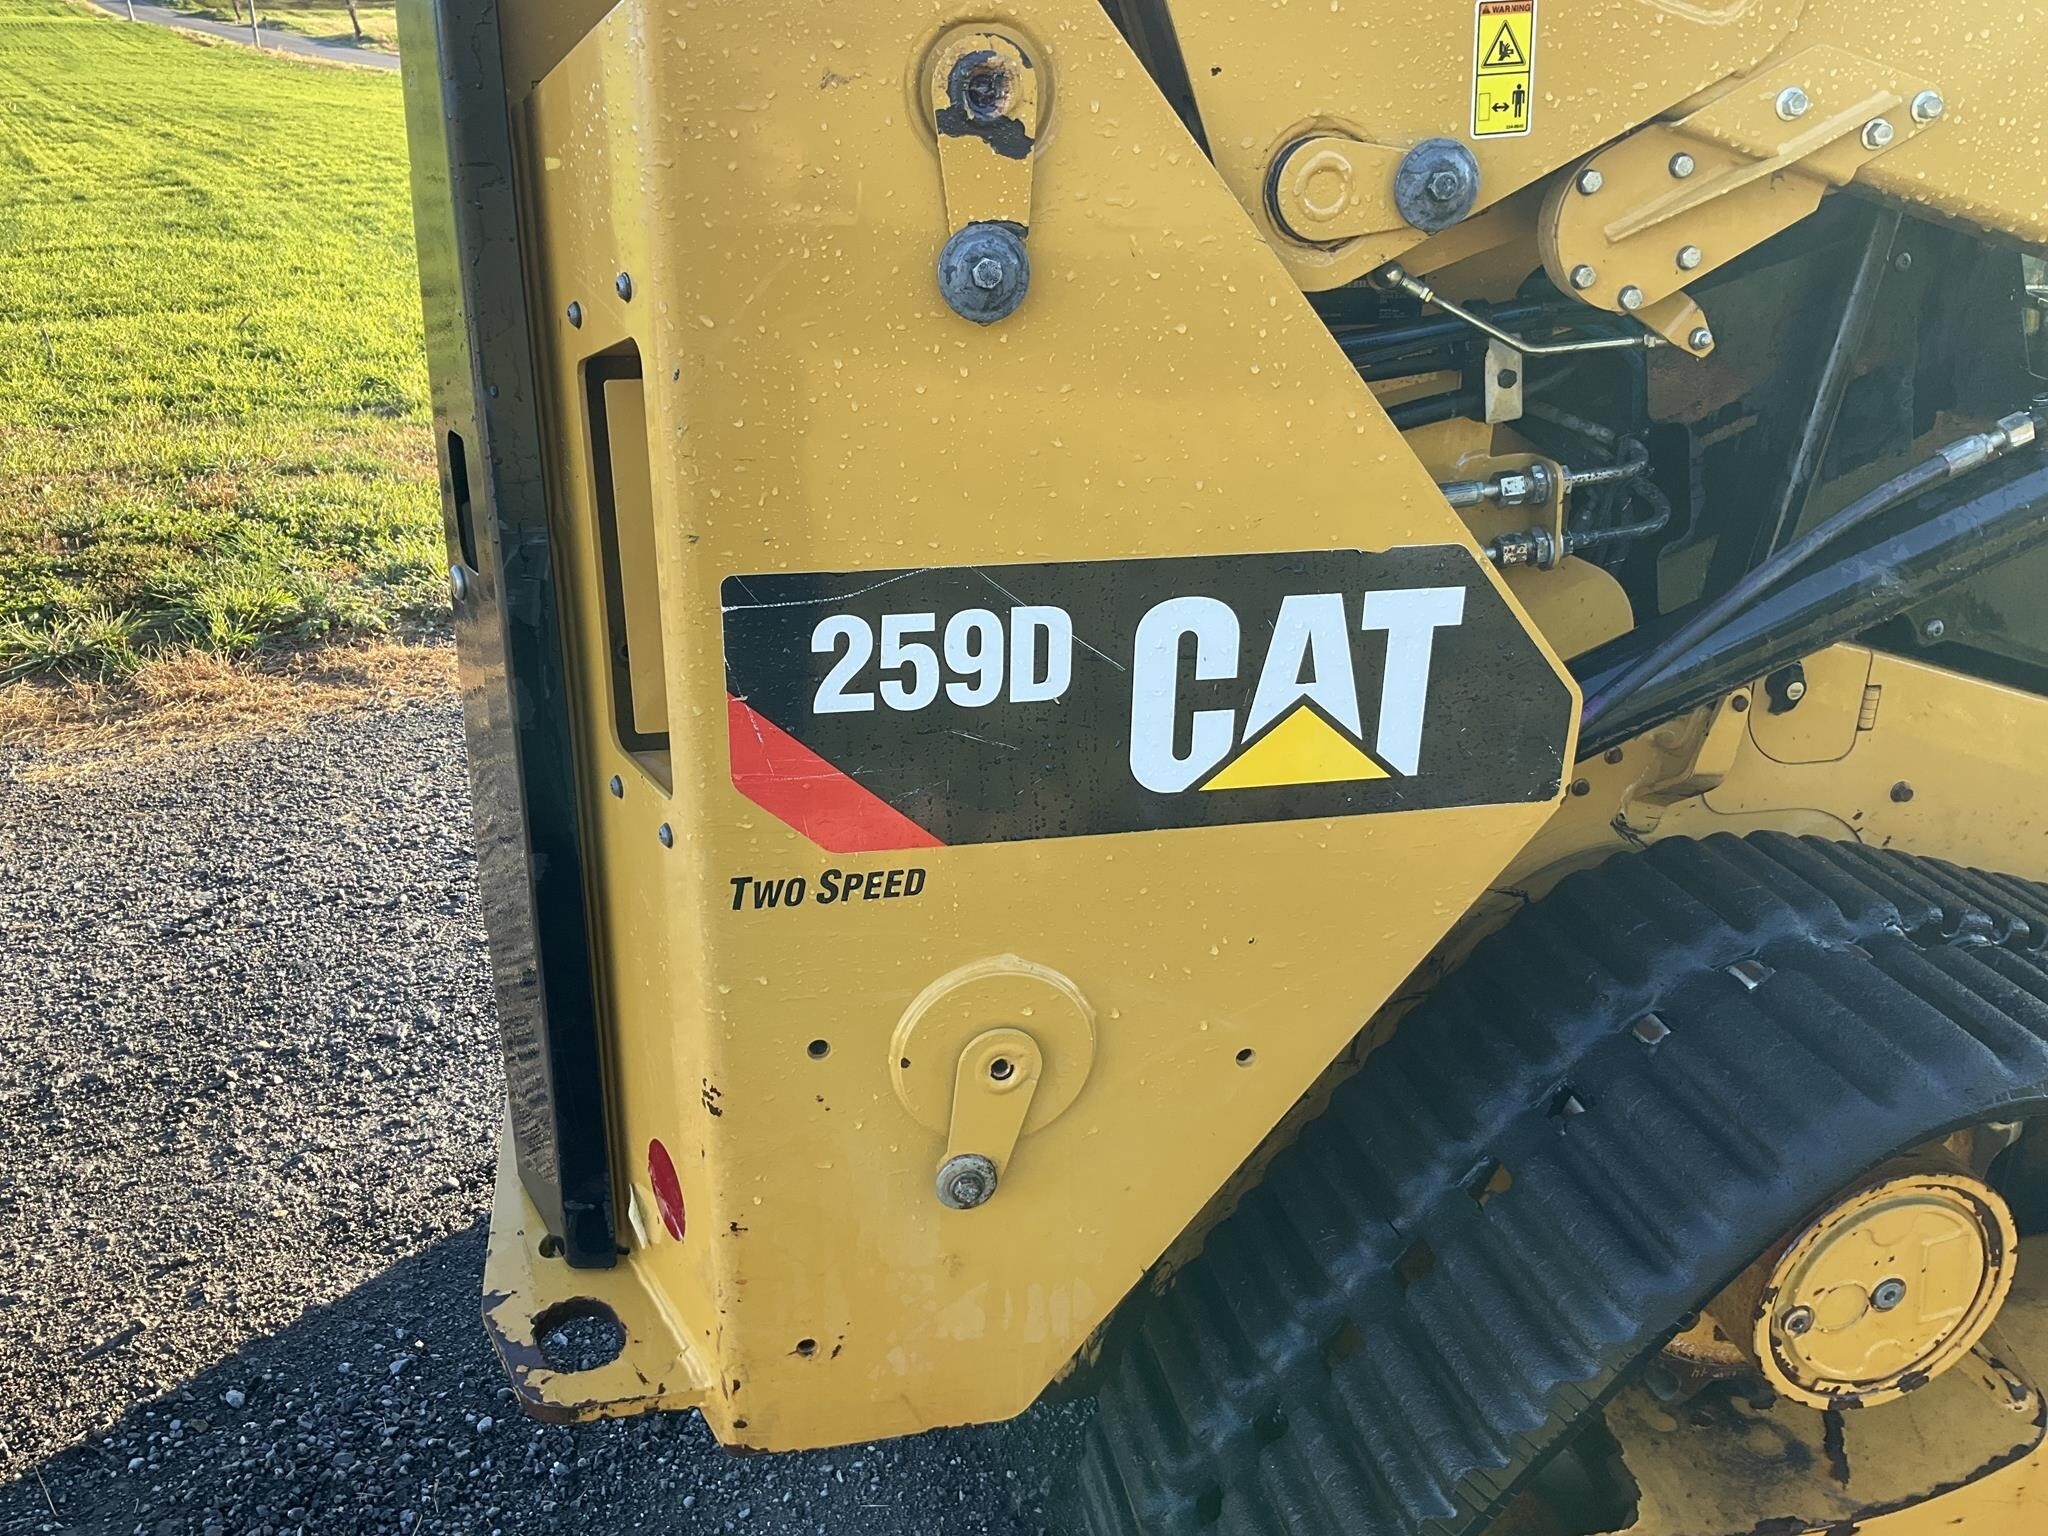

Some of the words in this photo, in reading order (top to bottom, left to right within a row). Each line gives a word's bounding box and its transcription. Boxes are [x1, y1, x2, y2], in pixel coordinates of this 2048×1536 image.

[1492, 4, 1531, 13] WARNING
[810, 605, 1072, 714] 259D
[1129, 586, 1466, 793] CAT
